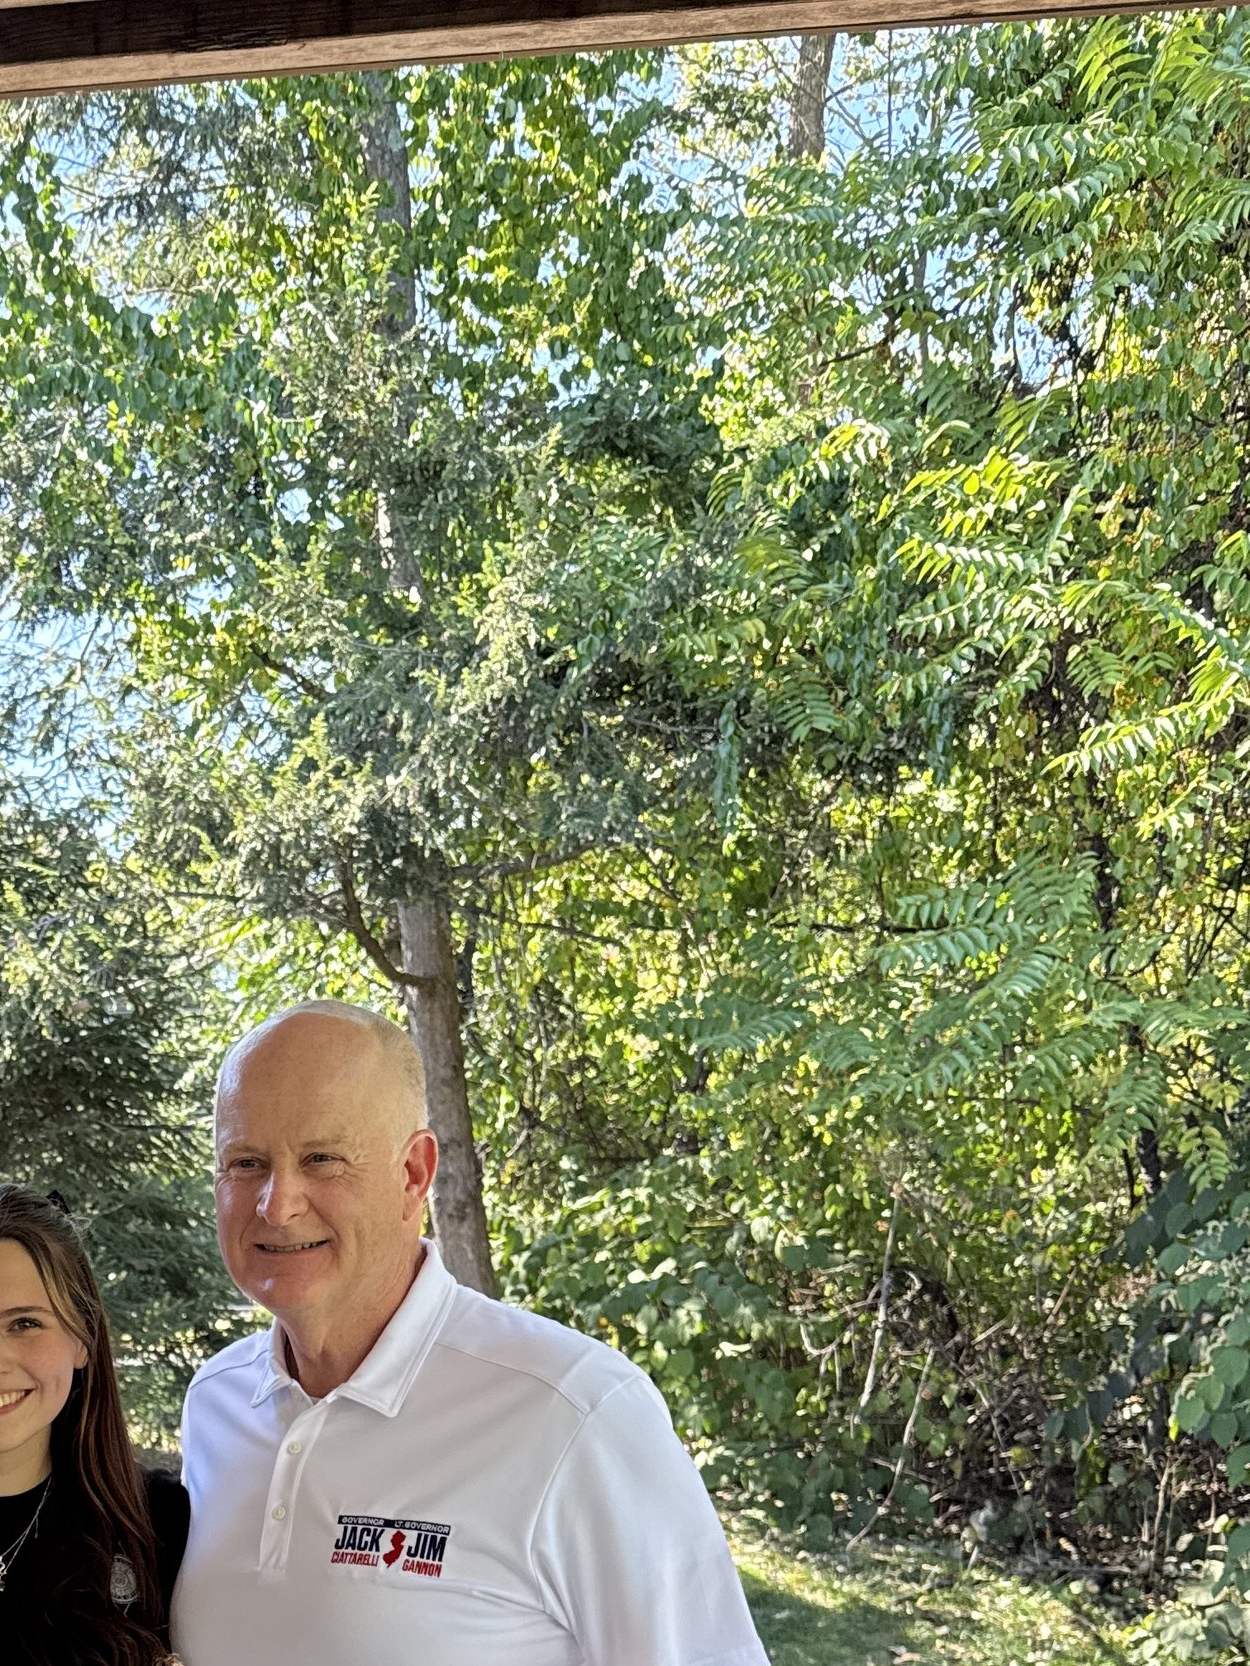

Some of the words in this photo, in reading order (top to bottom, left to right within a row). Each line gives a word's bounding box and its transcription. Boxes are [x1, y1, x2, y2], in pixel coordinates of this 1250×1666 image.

[341, 1516, 385, 1526] GOVERNOR
[405, 1521, 450, 1535] GOVERNOR
[334, 1525, 386, 1553] JACK
[406, 1532, 448, 1563] JIM
[330, 1551, 380, 1568] CIATTARELLI
[402, 1559, 443, 1578] GANNON
